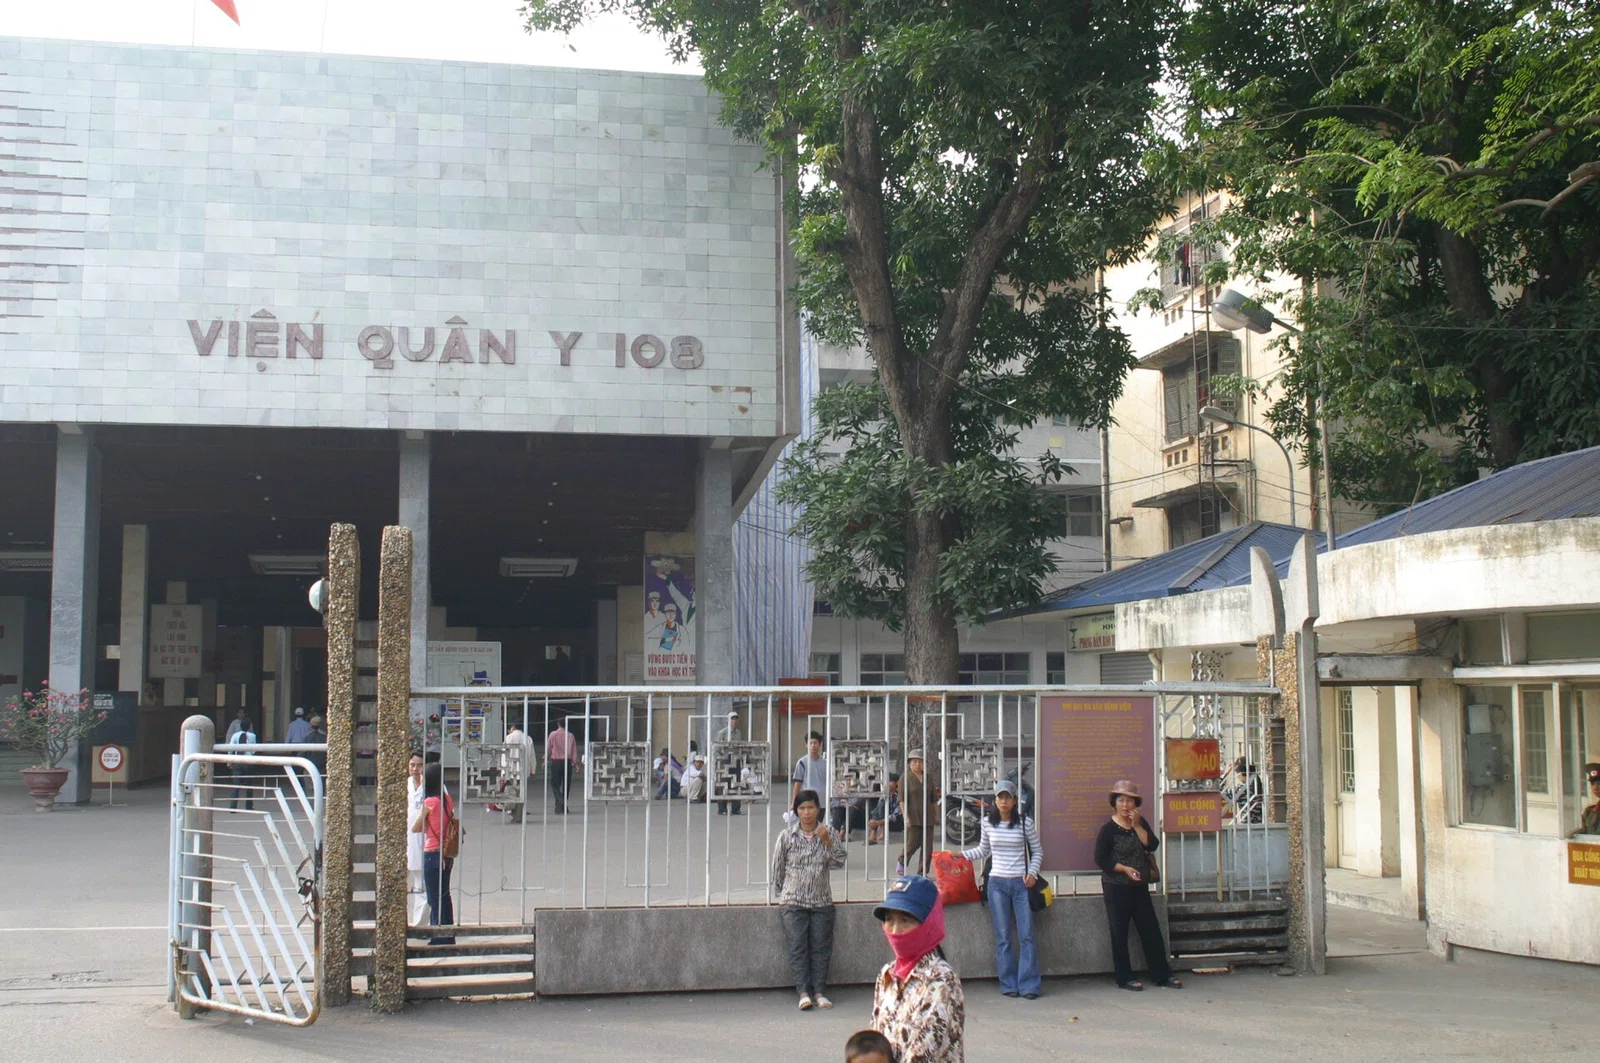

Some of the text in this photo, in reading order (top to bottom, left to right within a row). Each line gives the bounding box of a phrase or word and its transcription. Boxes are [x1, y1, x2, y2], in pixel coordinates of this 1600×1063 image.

[187, 308, 704, 372] VIỆN QUÂN Y 108
[1169, 800, 1187, 811] QUA
[1197, 816, 1209, 825] XE
